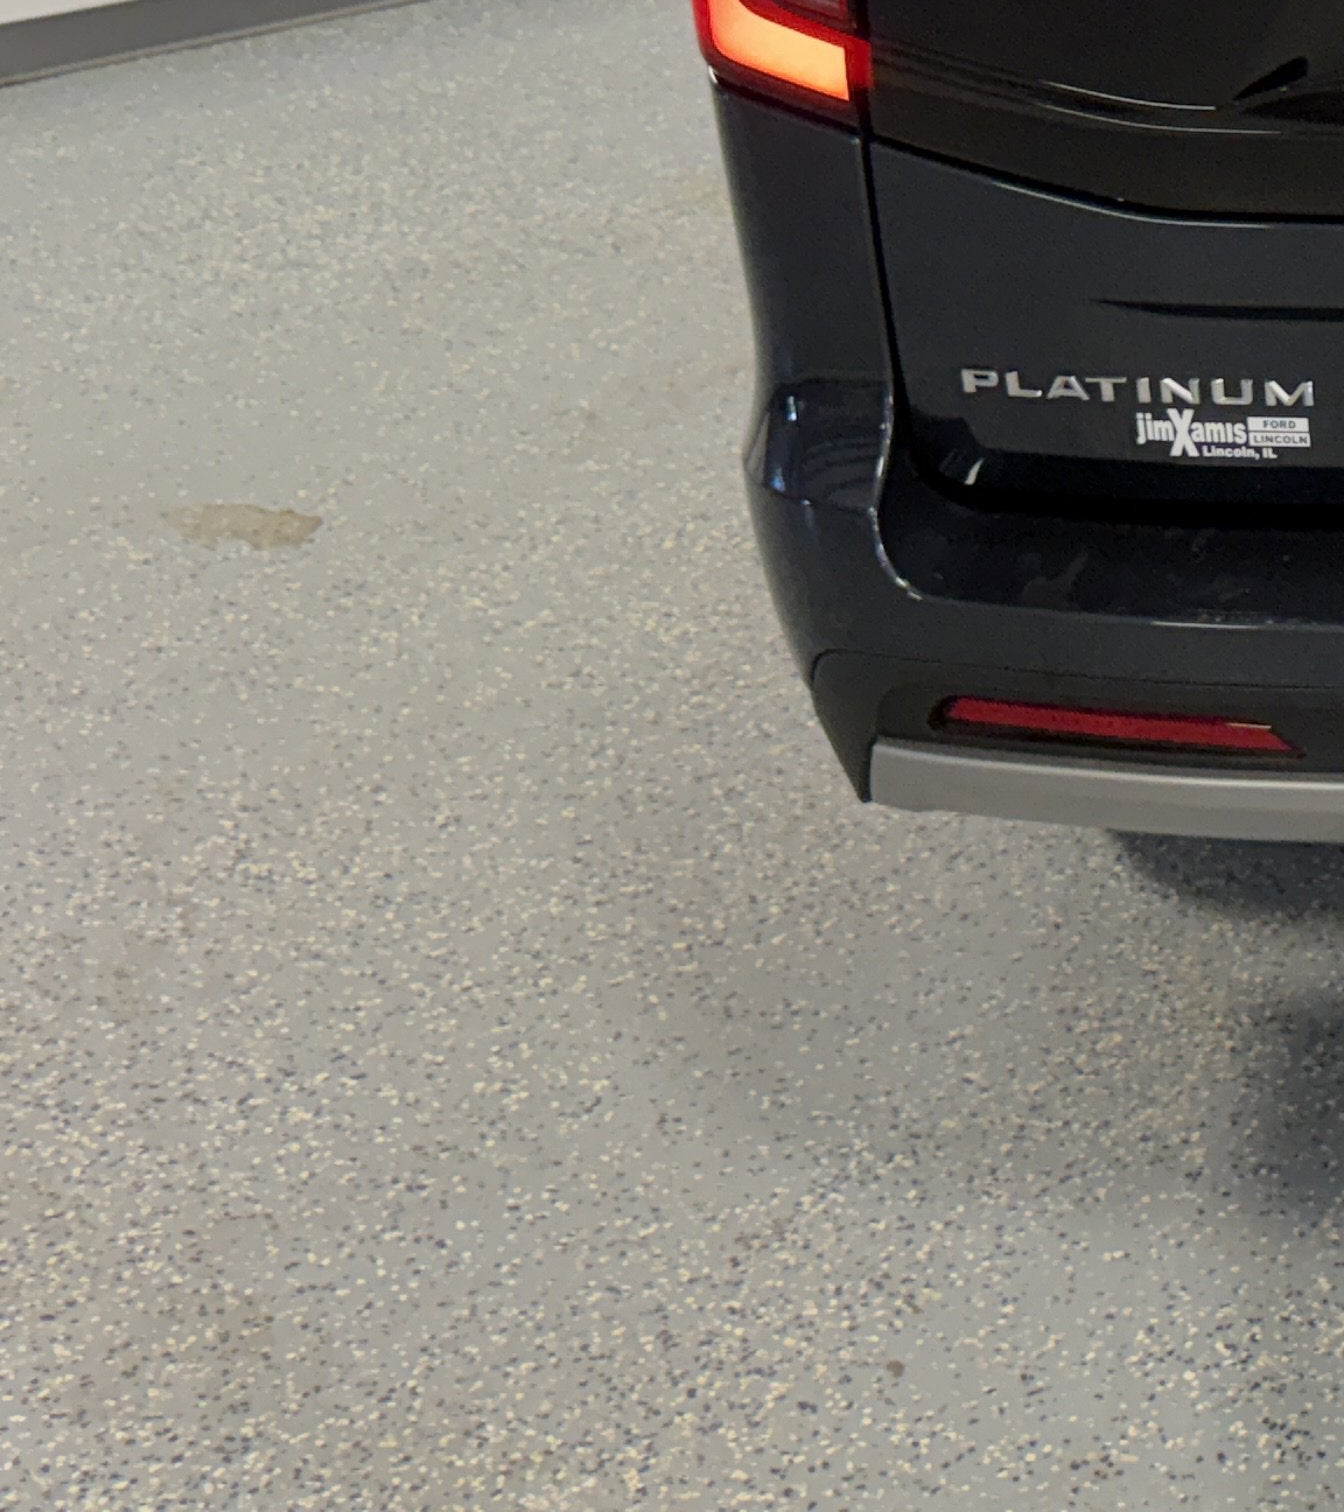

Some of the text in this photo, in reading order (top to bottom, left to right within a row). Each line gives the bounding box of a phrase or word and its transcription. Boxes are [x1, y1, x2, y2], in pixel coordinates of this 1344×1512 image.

[960, 367, 1315, 407] PLATINUM
[1263, 420, 1296, 429] FORD
[1253, 434, 1308, 445] LINCOLN
[1202, 445, 1278, 460] Lincoln, IL
